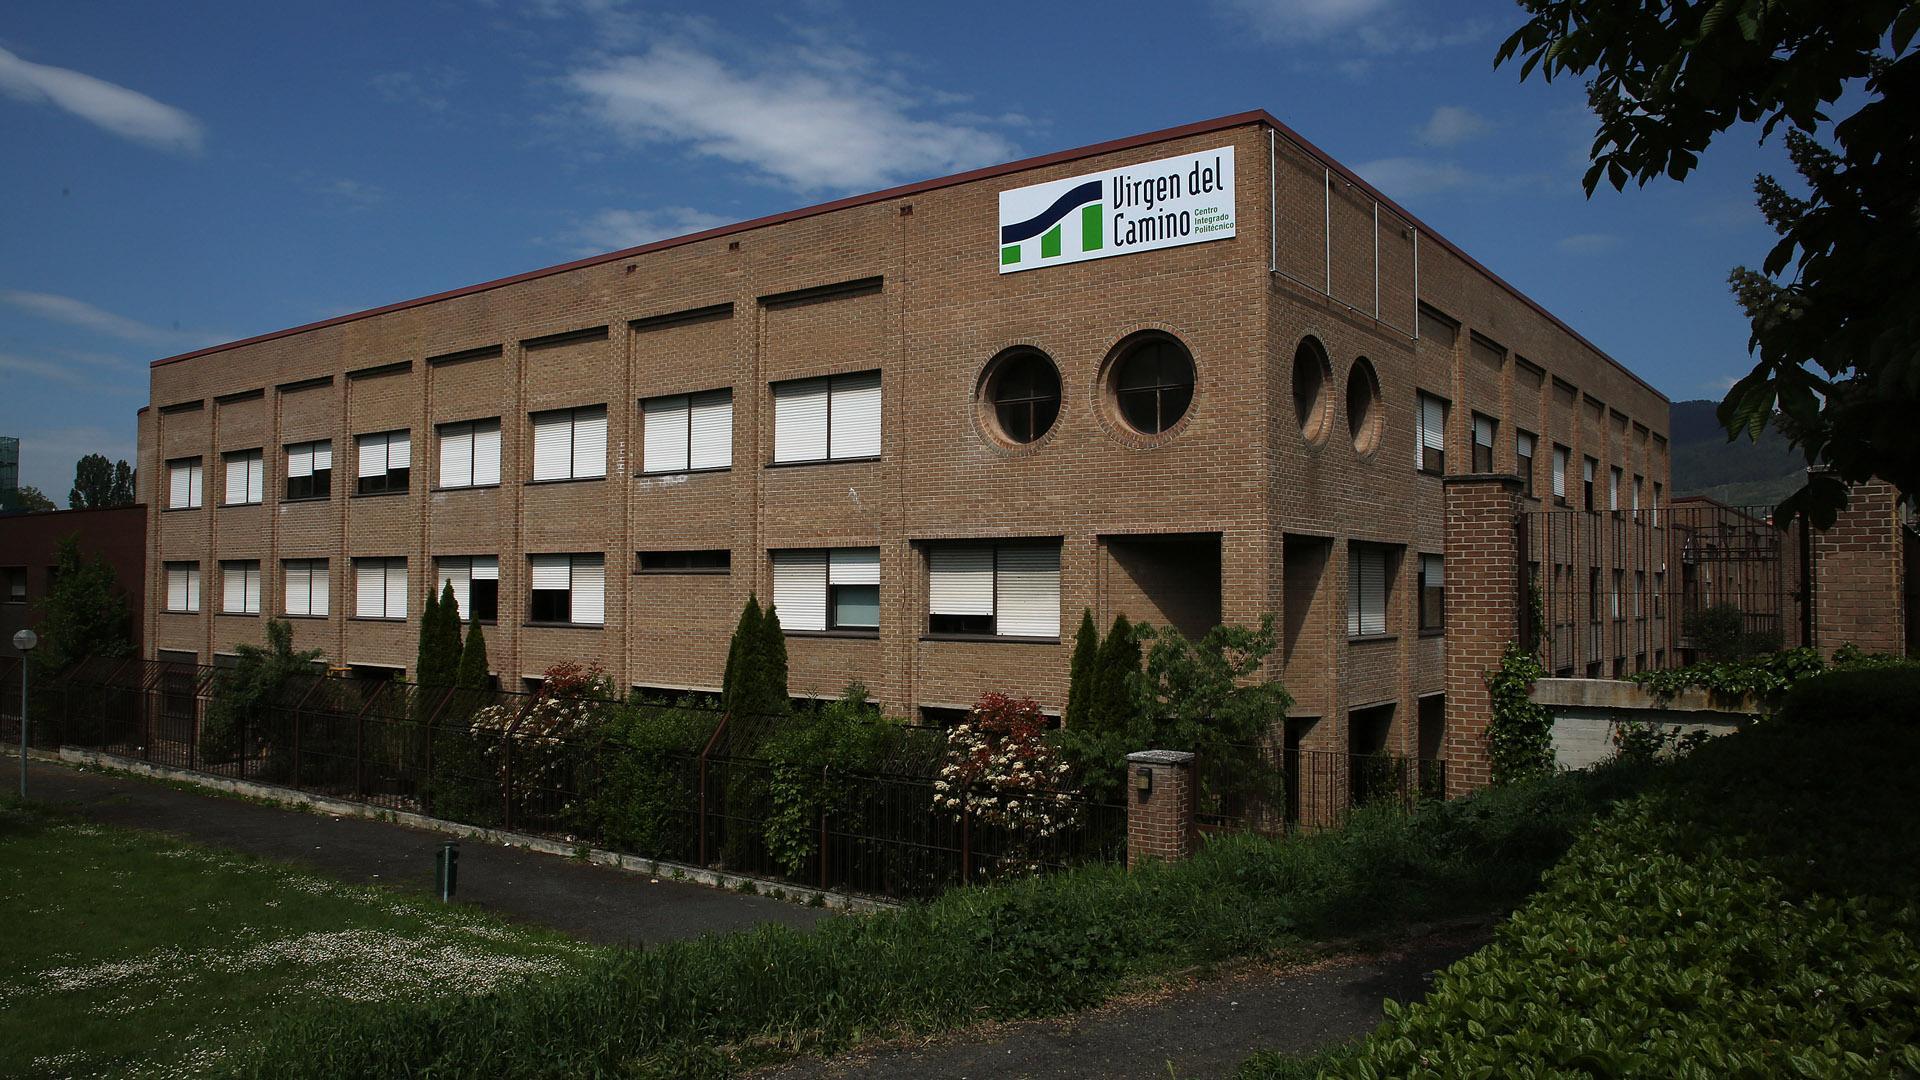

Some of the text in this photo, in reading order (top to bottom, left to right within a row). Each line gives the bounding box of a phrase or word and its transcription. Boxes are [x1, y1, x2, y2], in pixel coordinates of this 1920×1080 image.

[1113, 156, 1223, 210] Virgen del
[1194, 206, 1218, 216] Centro
[1194, 214, 1229, 225] Integrado
[1114, 208, 1190, 247] Camino
[1194, 222, 1234, 234] Politécnico
